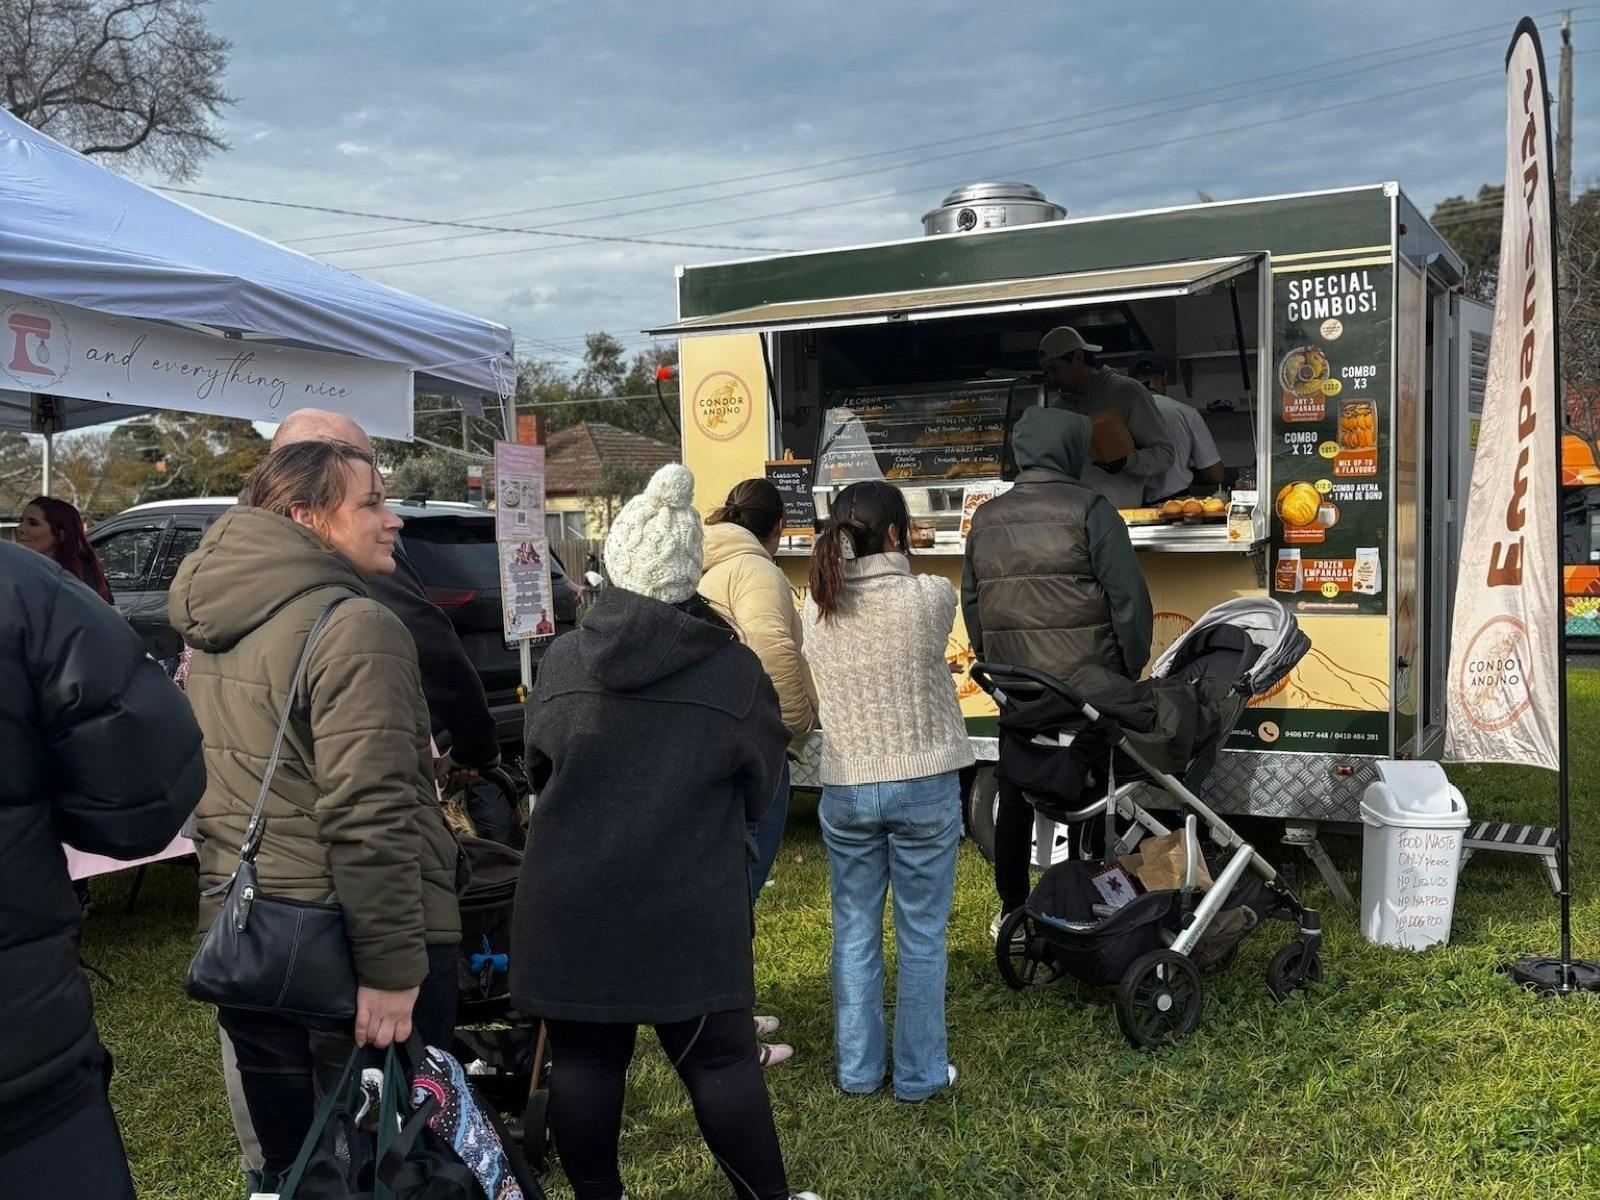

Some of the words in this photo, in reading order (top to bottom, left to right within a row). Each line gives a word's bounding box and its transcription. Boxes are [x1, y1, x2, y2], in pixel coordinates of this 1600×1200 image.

[1288, 270, 1374, 300] SPECIAL
[1288, 291, 1377, 322] COMBOS!
[86, 334, 148, 385] and
[152, 351, 293, 408] everything
[305, 380, 353, 400] nice
[1342, 365, 1376, 378] COMBO
[1354, 377, 1367, 389] X3
[699, 396, 744, 407] CONDOR
[703, 406, 741, 417] ANDINO
[1284, 431, 1318, 444] COMBO
[1292, 443, 1300, 455] X
[1303, 443, 1313, 455] 12
[1338, 459, 1351, 467] MIX
[1353, 459, 1362, 467] UP
[1342, 466, 1376, 474] FLAVOURS
[1332, 484, 1355, 492] COMBO
[1356, 483, 1379, 491] AVENA
[1339, 491, 1354, 500] PAN
[1313, 560, 1343, 569] FROZEN
[1304, 568, 1353, 577] EMPANADAS
[1471, 675, 1519, 687] ANDINO
[1399, 829, 1422, 849] FOOD
[1426, 832, 1456, 850] WASTE
[1399, 852, 1425, 866] ONLY
[1397, 876, 1409, 888] NO
[1398, 896, 1409, 907] NO
[1395, 917, 1407, 928] NO
